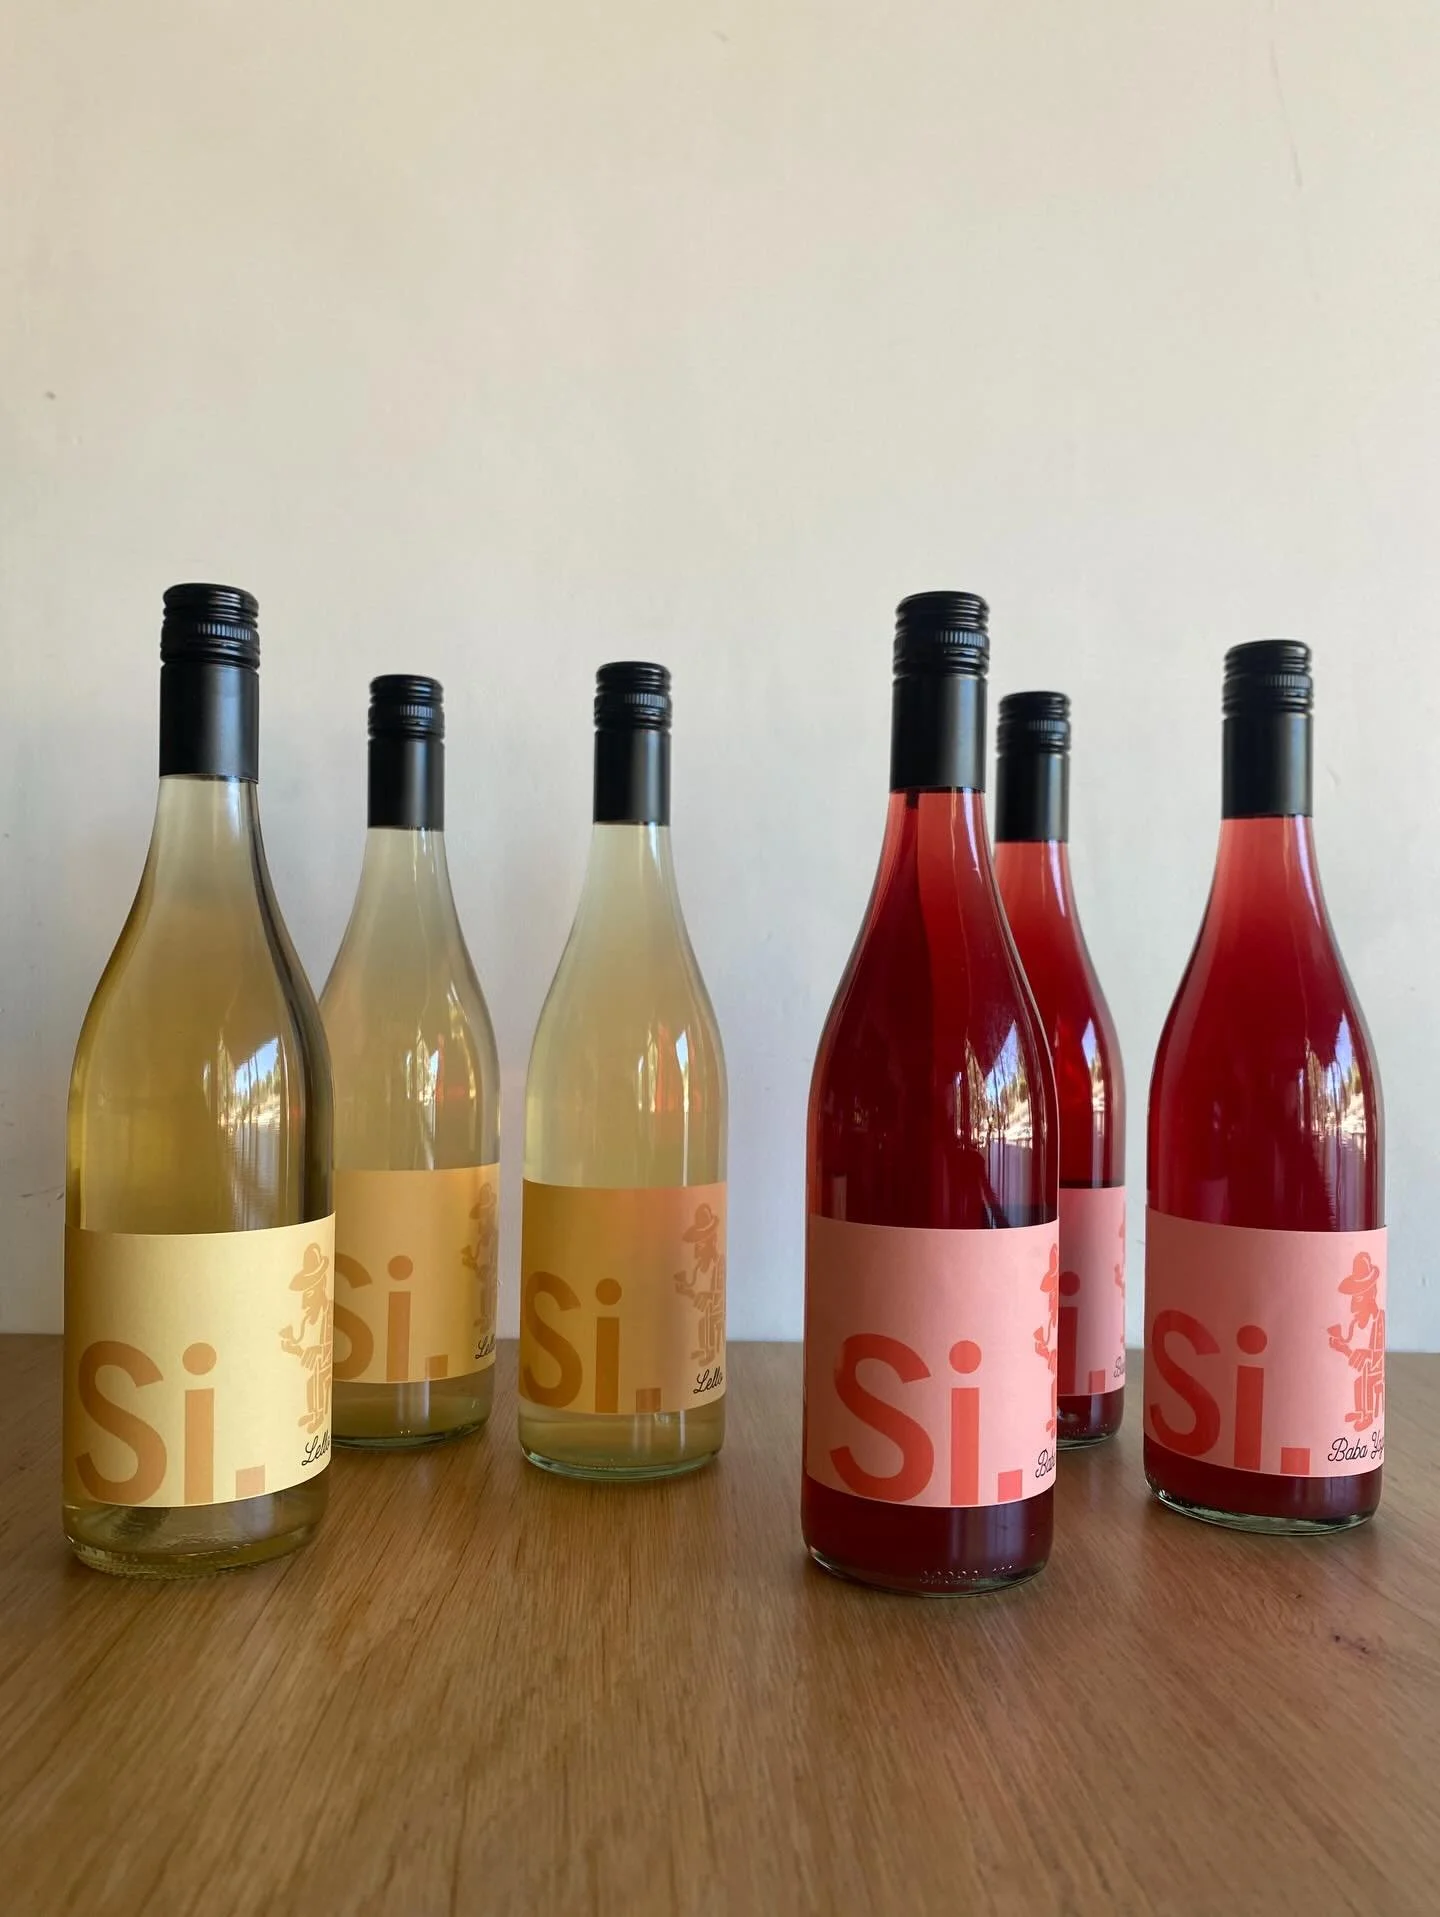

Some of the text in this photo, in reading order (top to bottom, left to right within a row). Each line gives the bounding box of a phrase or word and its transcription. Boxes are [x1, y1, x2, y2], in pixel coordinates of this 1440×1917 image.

[75, 1340, 266, 1505] Si.
[522, 1271, 662, 1413] Si.
[830, 1333, 1024, 1505] Si.
[1150, 1309, 1311, 1475] Si.
[1327, 1437, 1369, 1462] Baba
